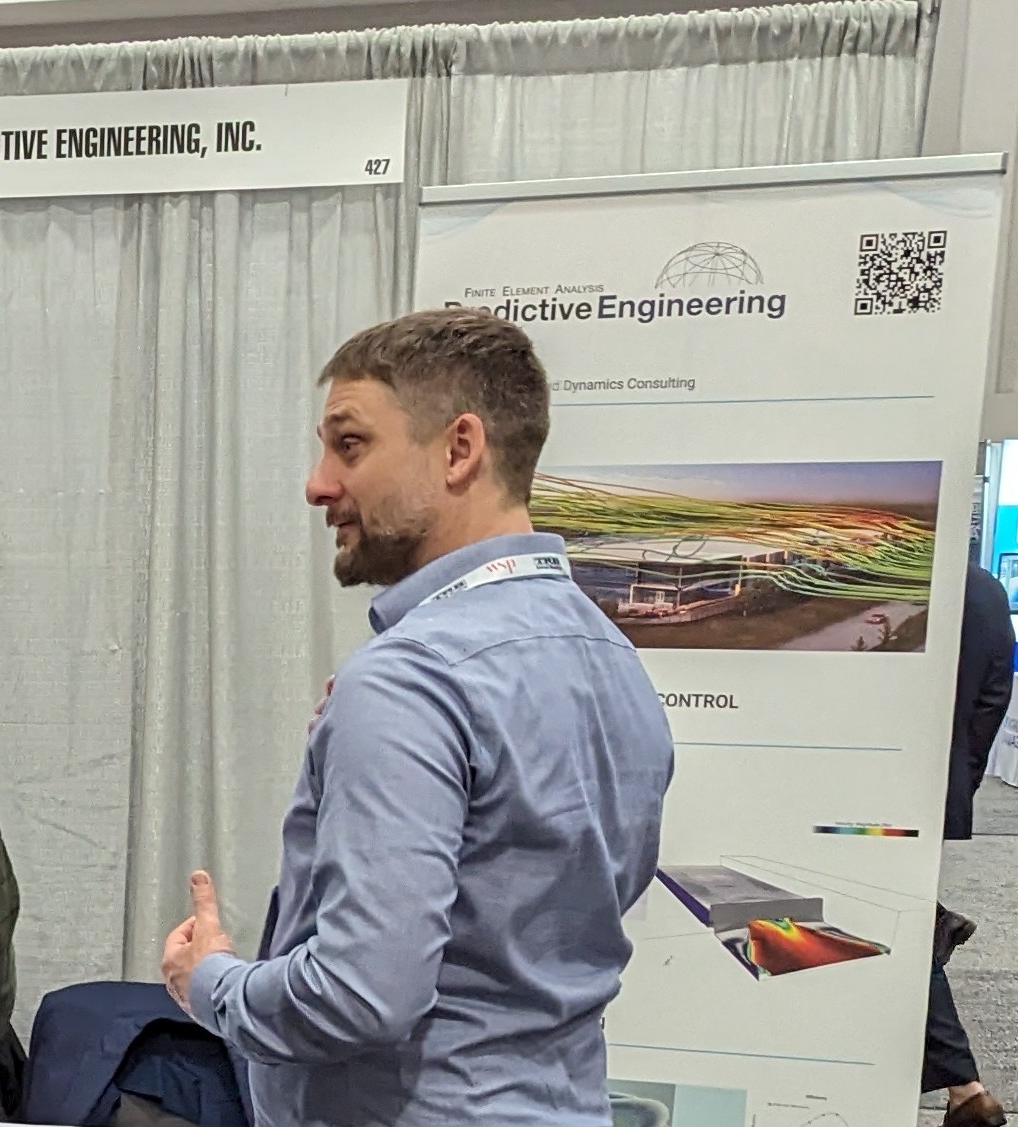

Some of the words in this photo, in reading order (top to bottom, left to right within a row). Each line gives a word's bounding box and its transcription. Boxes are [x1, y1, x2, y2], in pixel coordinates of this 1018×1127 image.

[55, 122, 208, 159] ENGINEERING,
[216, 120, 262, 153] INC.
[364, 158, 391, 176] 427
[445, 297, 593, 323] dictive
[597, 290, 787, 324] Engineering
[563, 379, 624, 394] Dynamics
[626, 377, 696, 391] Consulting
